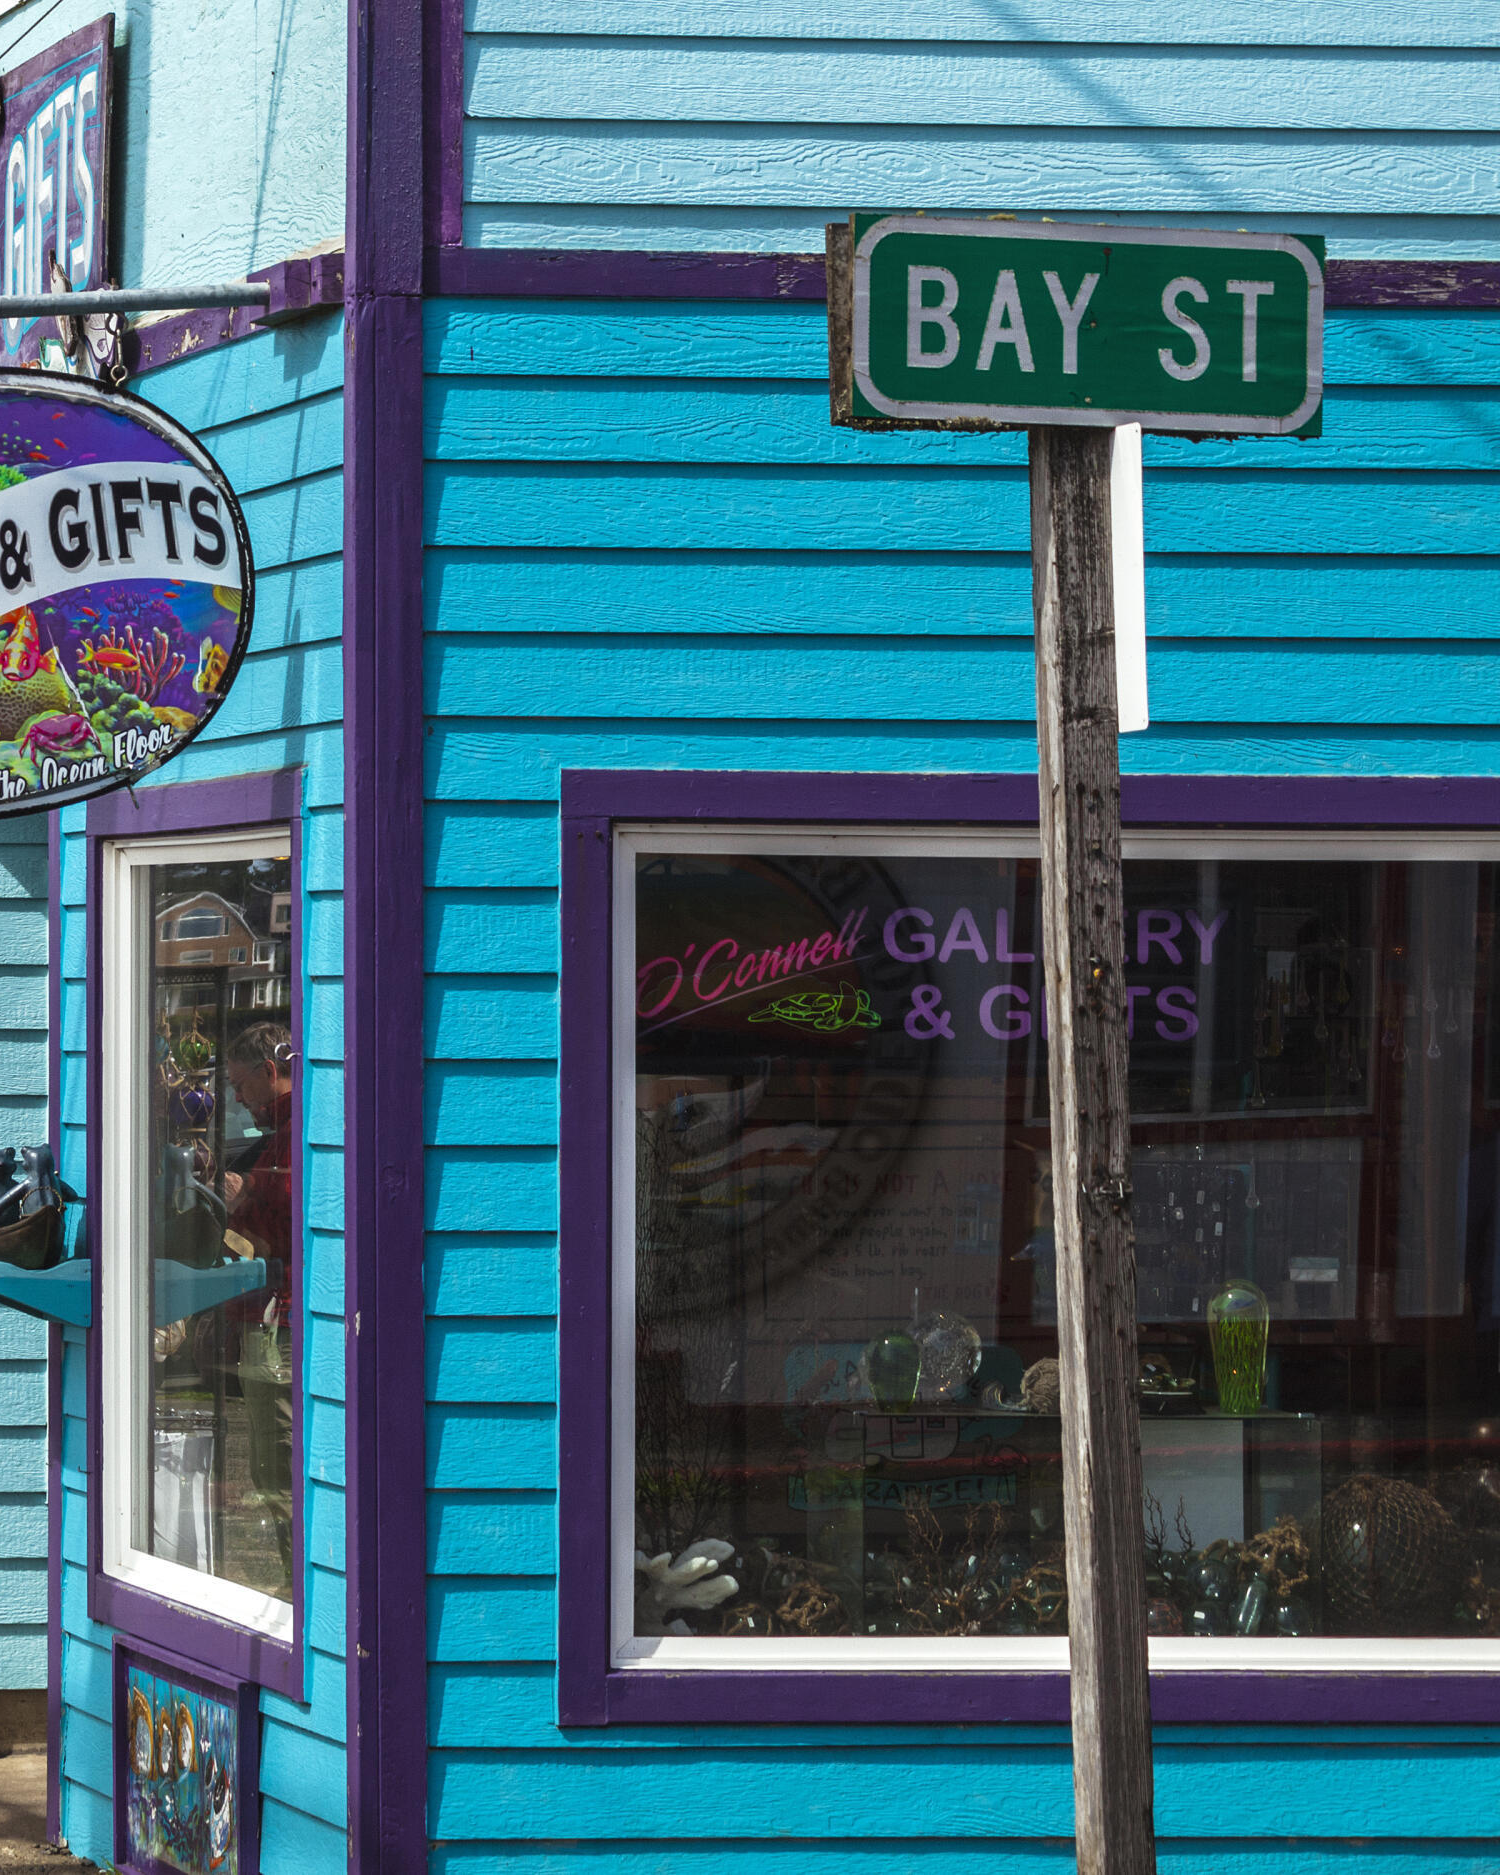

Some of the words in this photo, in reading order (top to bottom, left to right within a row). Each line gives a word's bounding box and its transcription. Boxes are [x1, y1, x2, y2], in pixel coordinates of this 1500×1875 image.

[3, 66, 100, 361] GIFTS
[906, 264, 1100, 375] BAY
[1158, 275, 1275, 383] ST
[48, 475, 229, 574] GIFTS
[41, 754, 108, 791] Ocean
[112, 723, 173, 770] Floor
[882, 906, 1230, 966] GALRY
[903, 984, 956, 1041] &
[978, 984, 1200, 1042] GTS
